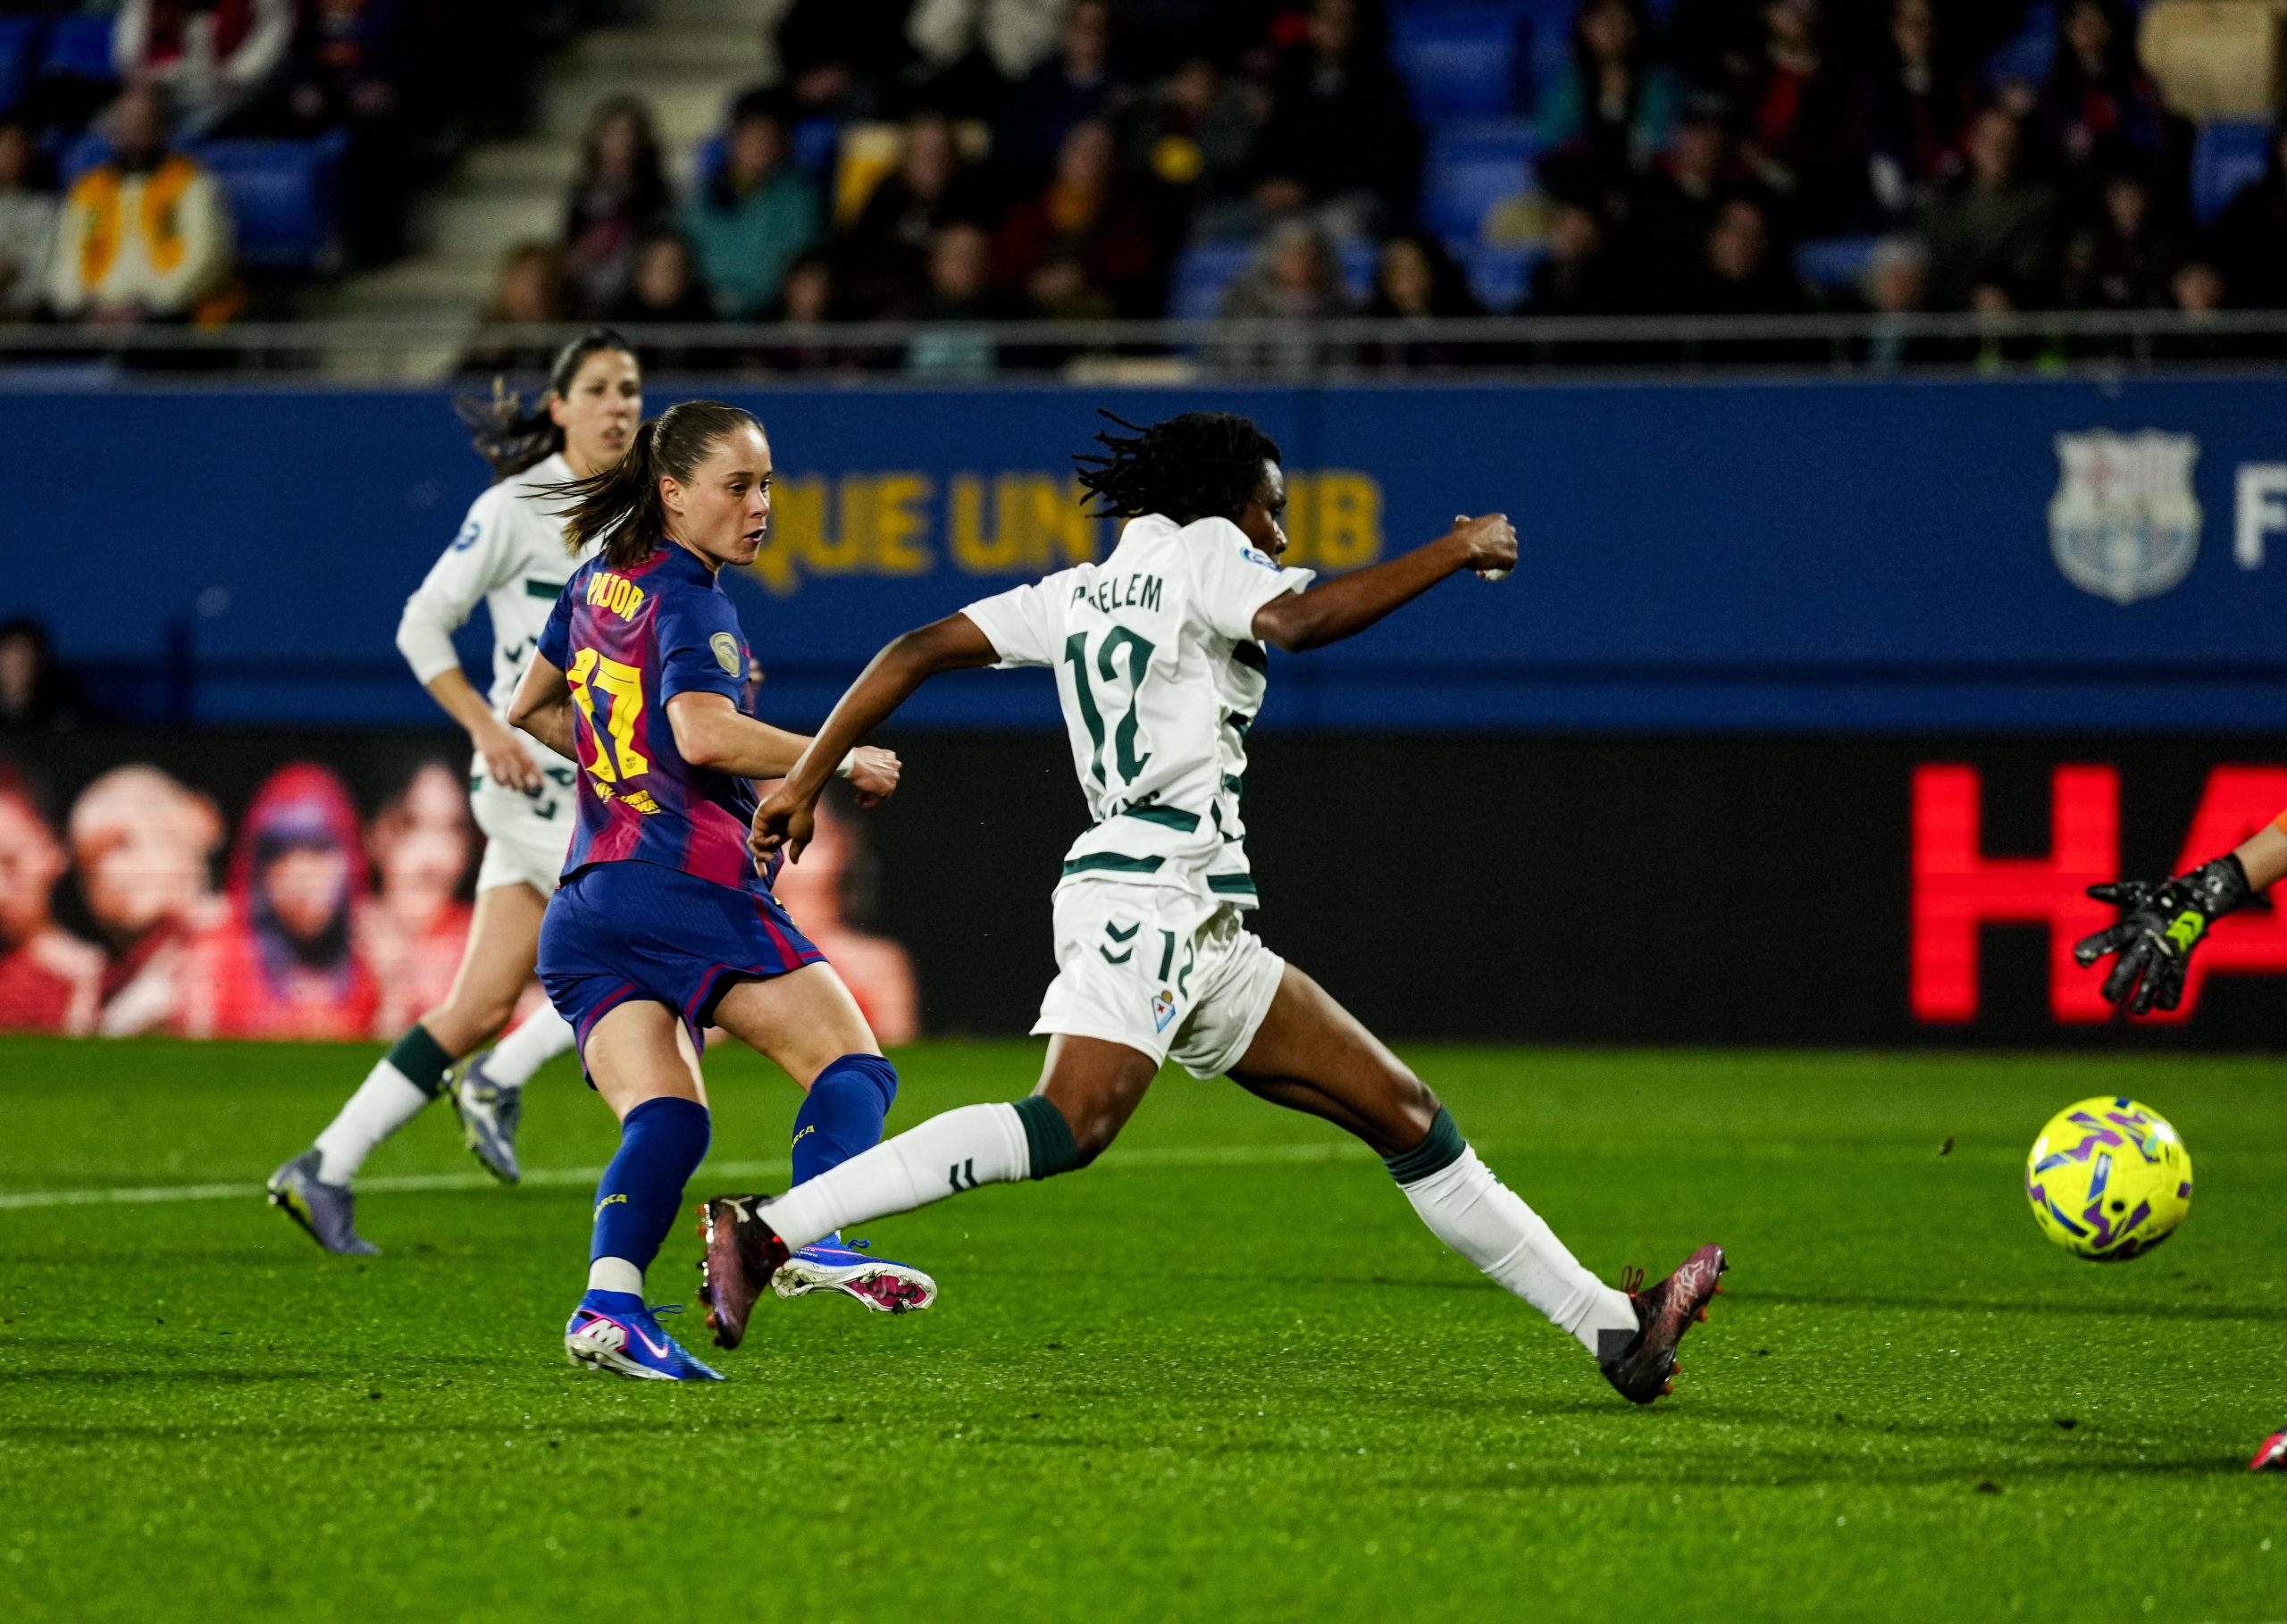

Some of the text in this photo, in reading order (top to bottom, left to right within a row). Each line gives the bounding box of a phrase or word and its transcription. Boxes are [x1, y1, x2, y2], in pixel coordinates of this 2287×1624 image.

[586, 572, 644, 622] PAJOR
[566, 647, 649, 783] 17
[1064, 625, 1156, 790] 12
